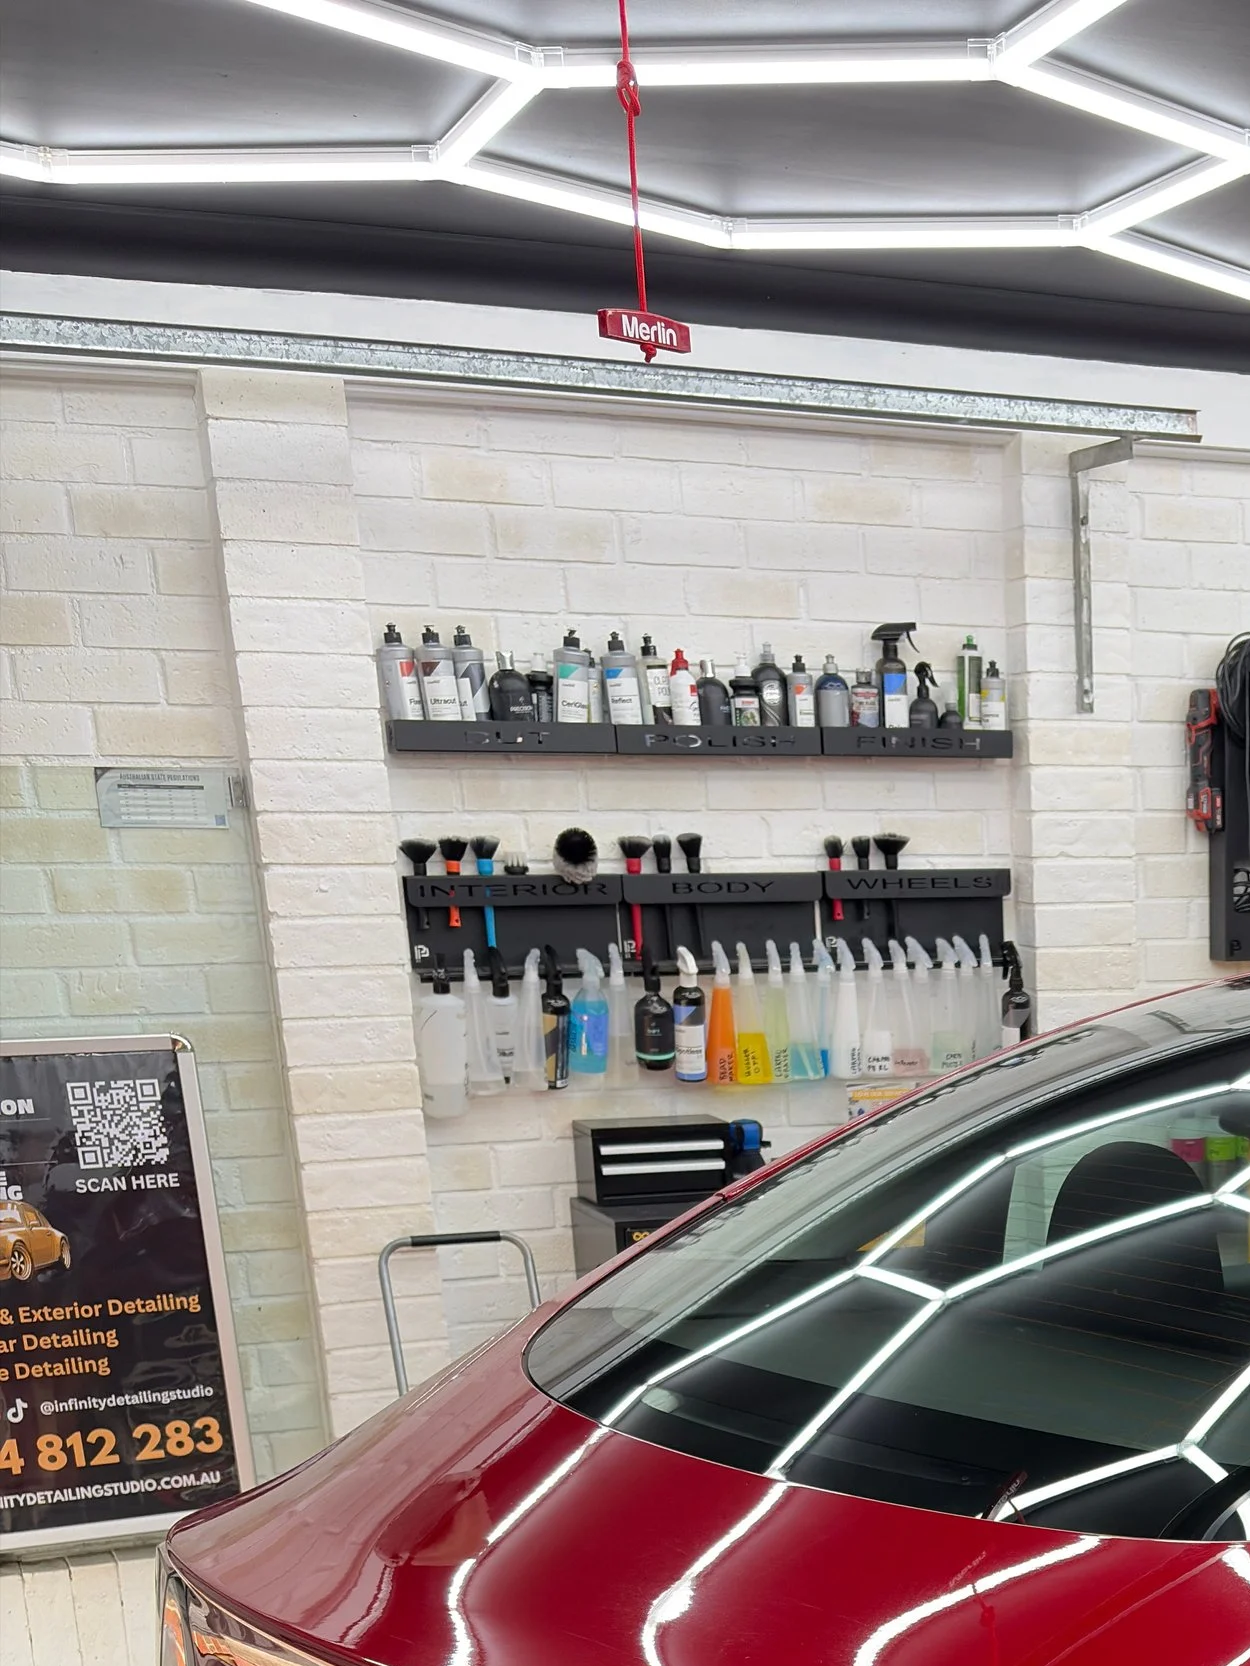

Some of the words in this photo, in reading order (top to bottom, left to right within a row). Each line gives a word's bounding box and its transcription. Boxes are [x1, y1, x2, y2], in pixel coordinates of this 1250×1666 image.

[621, 314, 678, 347] Merlin
[645, 733, 796, 748] POLISH
[857, 736, 981, 751] FINISH
[419, 883, 608, 898] INTERIOR
[672, 881, 775, 894] BODY
[848, 876, 992, 889] WHEELS
[0, 1098, 35, 1116] ON
[75, 1176, 128, 1194] SCAN
[132, 1173, 180, 1190] HERE
[18, 1301, 103, 1323] Exterior
[107, 1293, 201, 1316] Detailing
[22, 1328, 119, 1351] Detailing
[14, 1357, 111, 1380] Detailing
[40, 1385, 214, 1415] @infinitydetailingstudio
[36, 1427, 120, 1471] 812
[132, 1416, 223, 1461] 283
